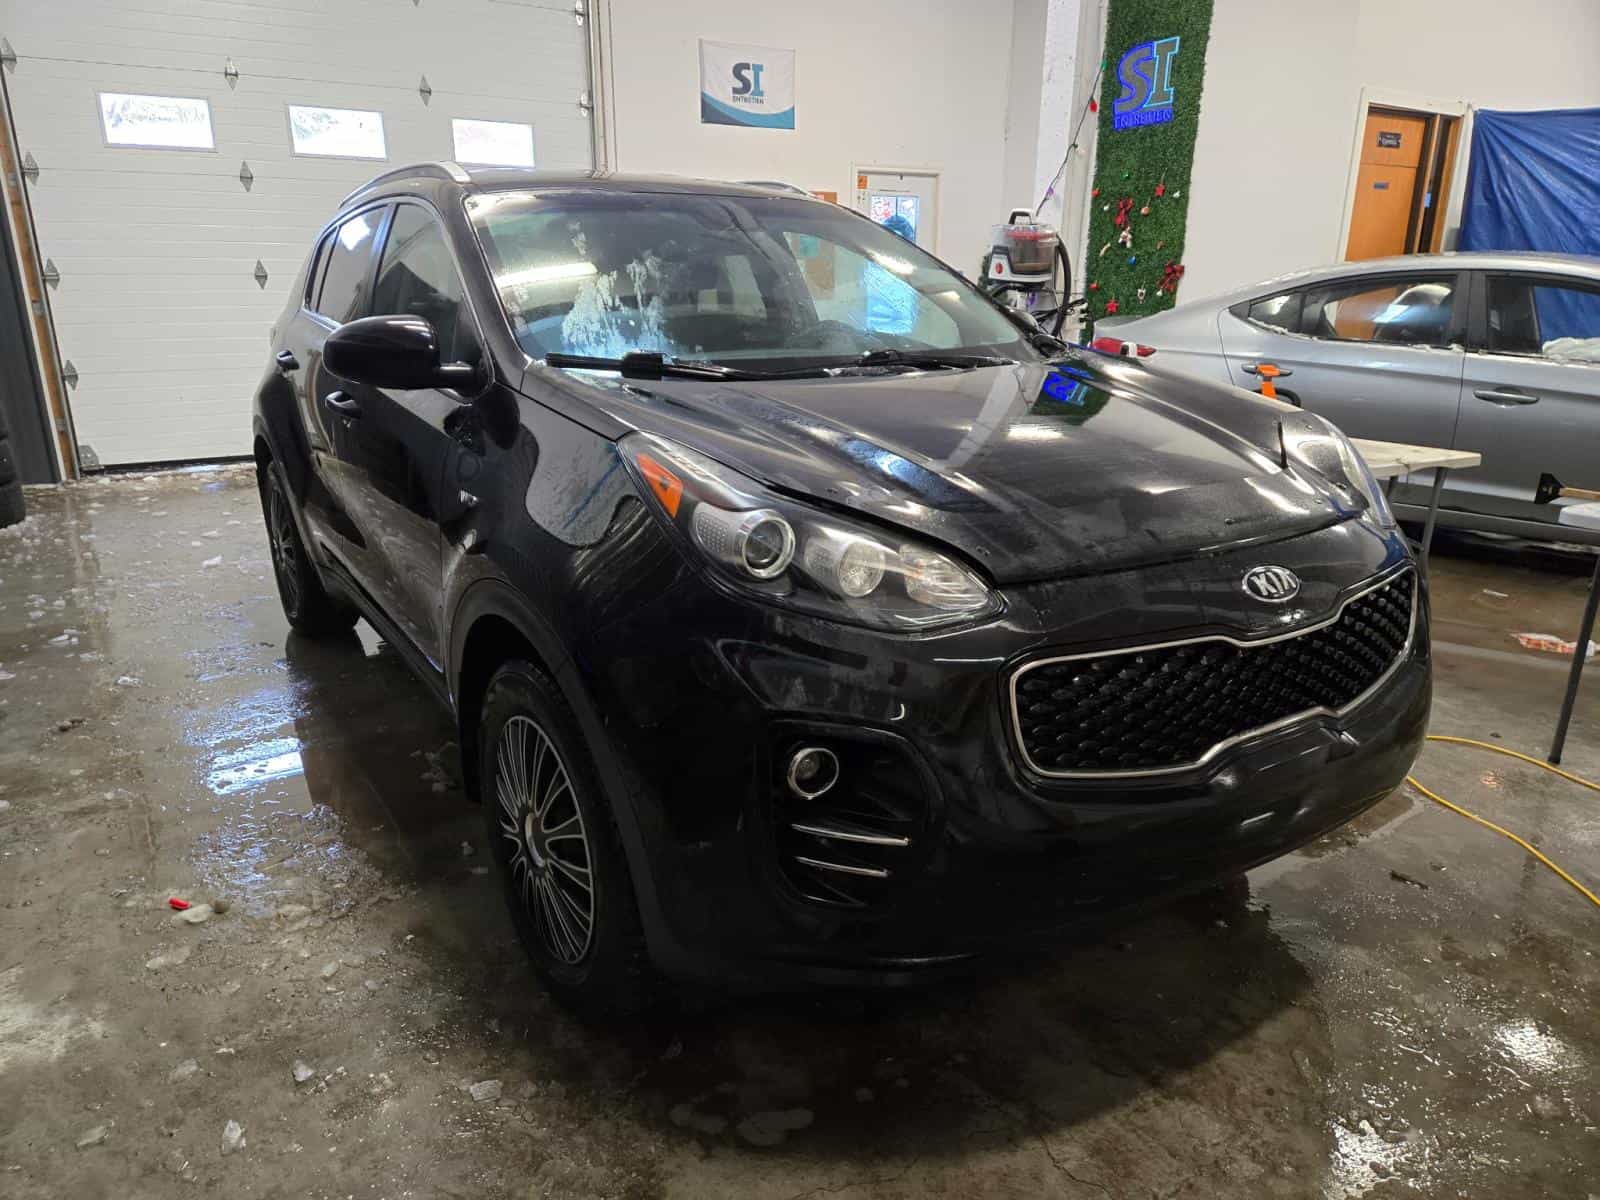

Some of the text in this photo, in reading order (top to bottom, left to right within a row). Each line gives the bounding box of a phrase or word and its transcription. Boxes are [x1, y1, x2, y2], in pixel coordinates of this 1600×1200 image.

[732, 62, 764, 96] SI
[1113, 36, 1180, 113] SI
[1249, 571, 1297, 596] KIA
